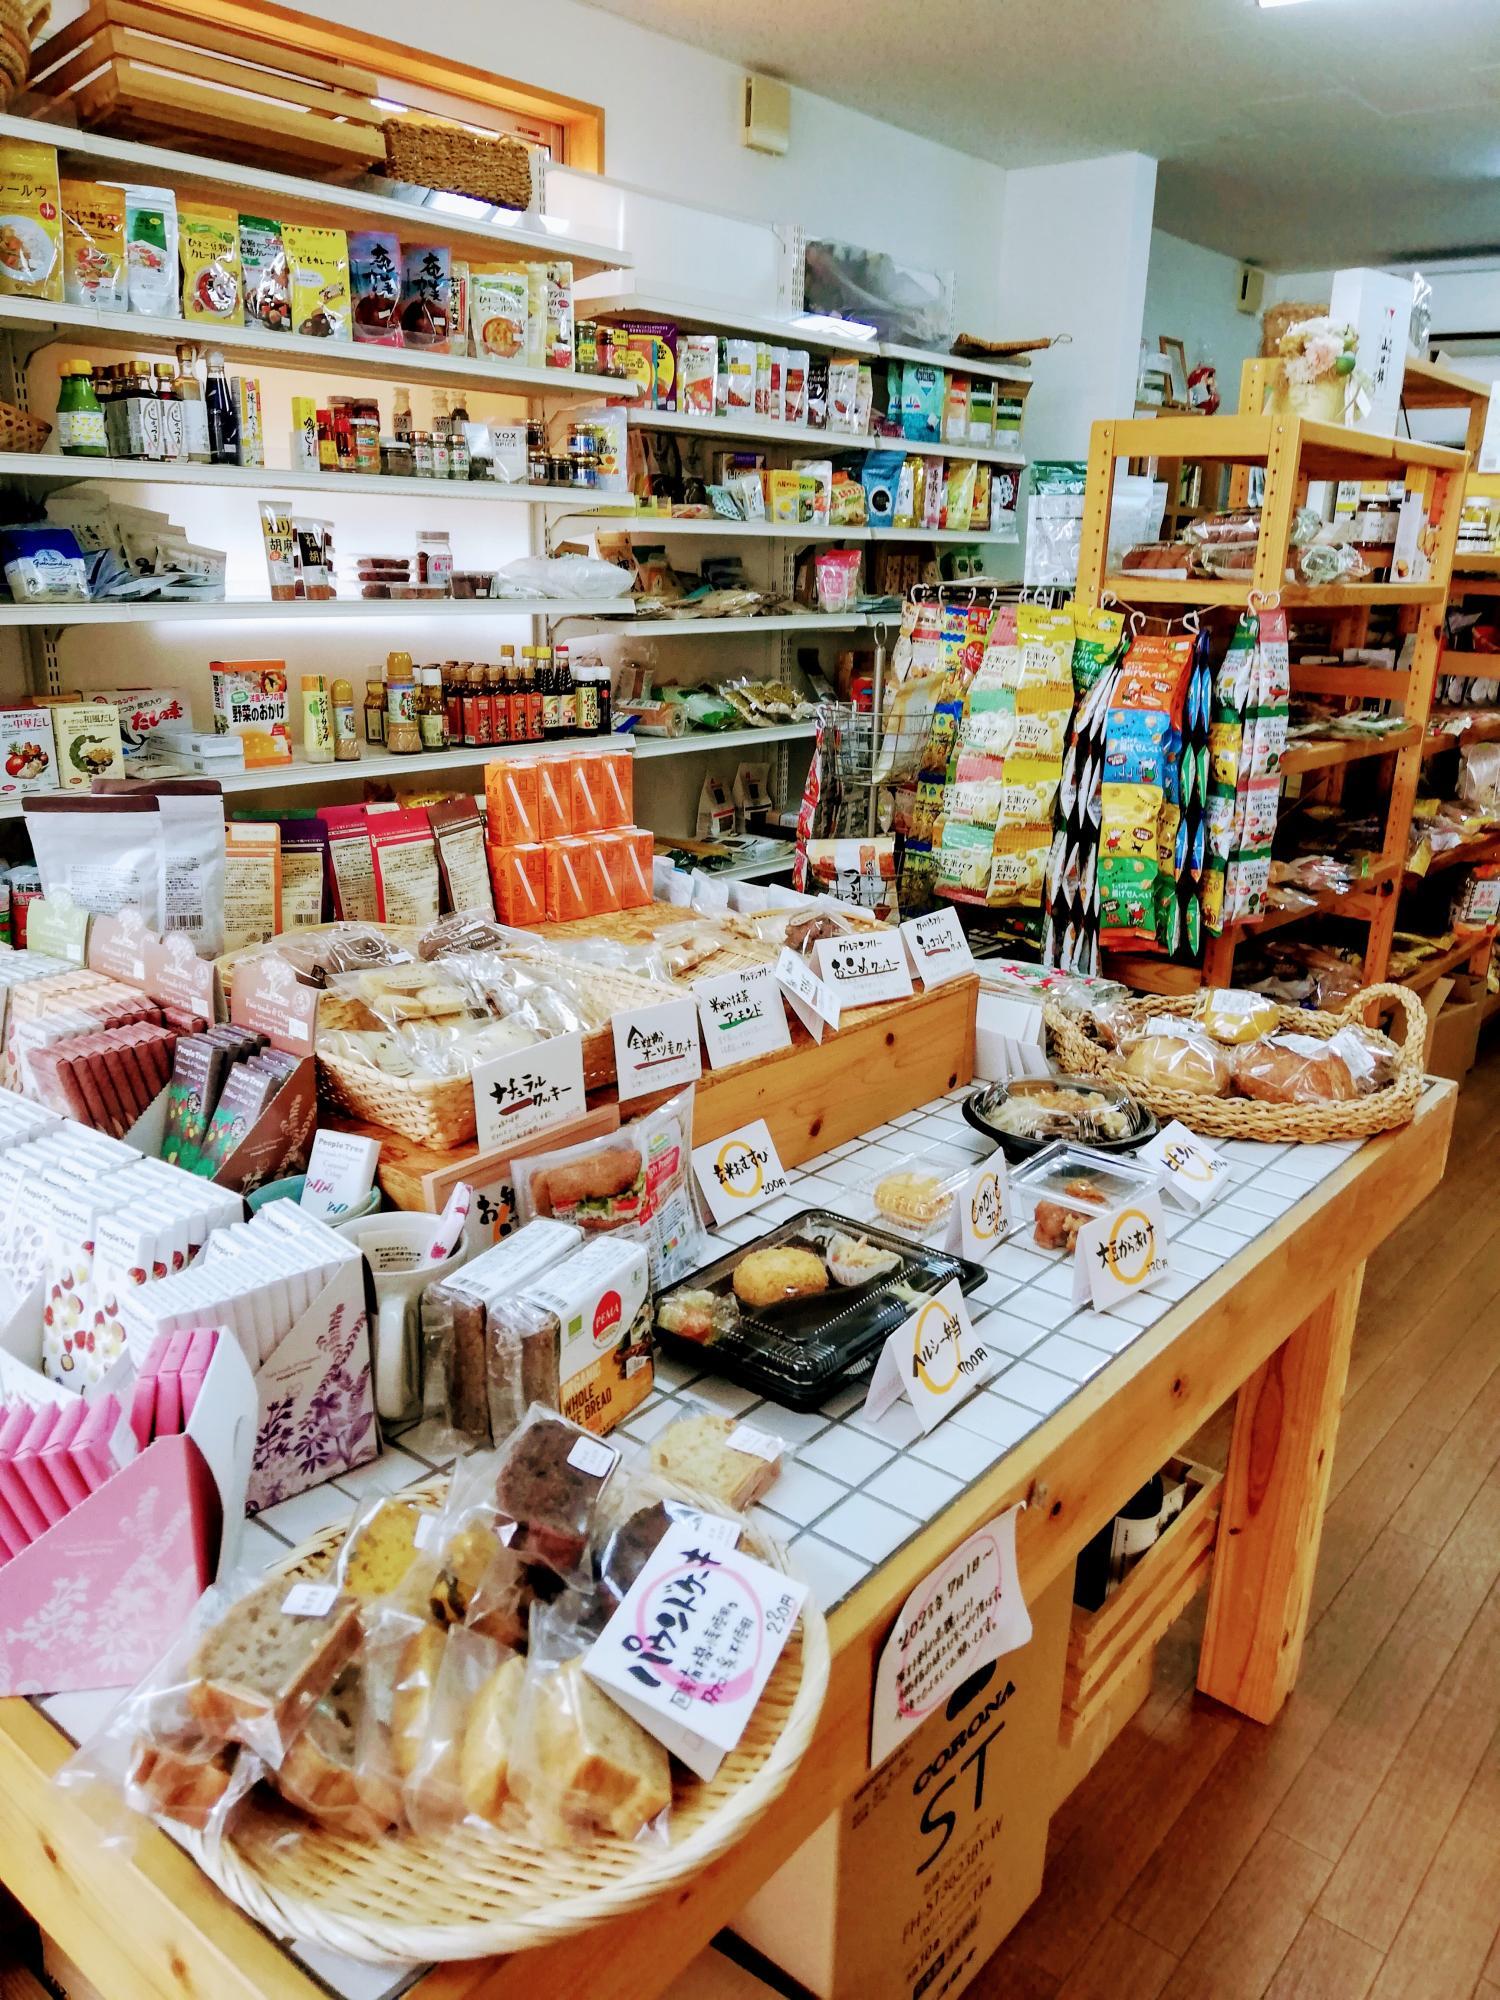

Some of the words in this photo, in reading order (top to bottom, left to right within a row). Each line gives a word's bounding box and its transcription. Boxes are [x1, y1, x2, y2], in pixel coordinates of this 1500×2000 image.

[268, 537, 294, 551] 胡麻
[131, 700, 183, 732] だしの素
[232, 702, 285, 723] 野菜のおかげ
[838, 939, 883, 953] グルテンフリー
[489, 1073, 547, 1105] ナチュラル
[532, 1085, 573, 1108] クッキー
[318, 1137, 344, 1150] People
[344, 1143, 364, 1154] Tree
[712, 1148, 769, 1185] 玄米おむすび
[761, 1176, 787, 1195] 200円
[971, 1174, 1001, 1224] じゃがいも
[52, 1204, 73, 1217] People
[71, 1212, 88, 1225] Tree
[99, 1226, 120, 1241] People
[119, 1237, 136, 1250] Tree
[1096, 1221, 1155, 1270] 大豆からあげ
[595, 1303, 620, 1328] PEMA
[912, 1312, 963, 1378] ヘルシー弁当
[957, 1345, 989, 1376] 700円
[564, 1382, 595, 1418] WHOLE
[585, 1387, 612, 1420] BREAD
[621, 1547, 723, 1688] パウンドケーキ
[912, 1680, 1017, 1796] CORONA
[916, 1721, 1005, 1876] ST
